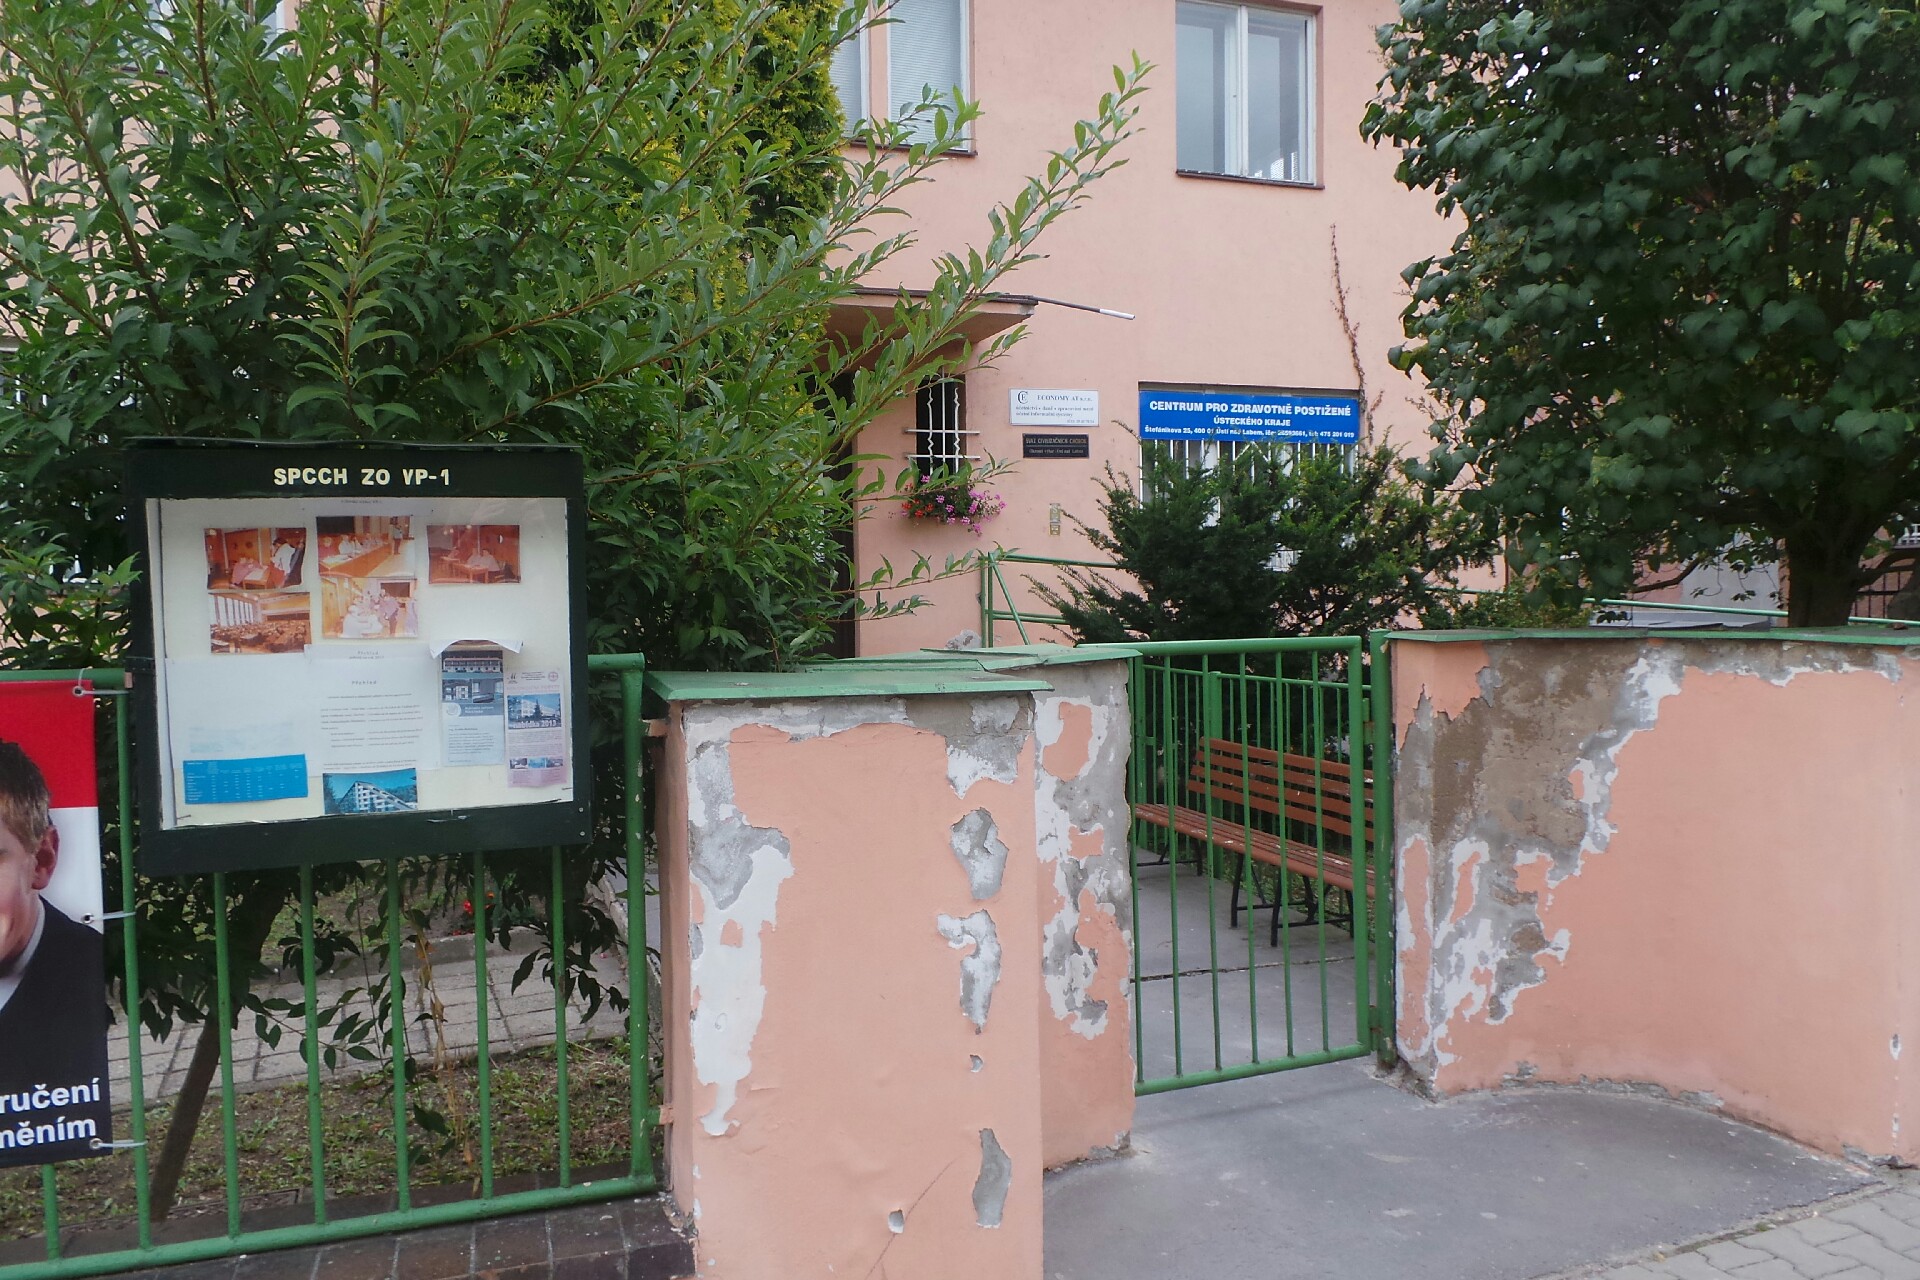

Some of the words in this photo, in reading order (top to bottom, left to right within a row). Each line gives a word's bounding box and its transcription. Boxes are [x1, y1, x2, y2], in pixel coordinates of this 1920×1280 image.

[1150, 401, 1203, 411] CENTRUM
[1206, 403, 1228, 412] PRO
[1230, 404, 1292, 414] ZDRAVOTNĚ
[1294, 405, 1351, 416] POSTIŽENÉ
[1214, 415, 1263, 425] ÚSTECKÉHO
[273, 467, 348, 485] SPCCH
[361, 468, 390, 485] ZO
[402, 468, 449, 486] VP-1
